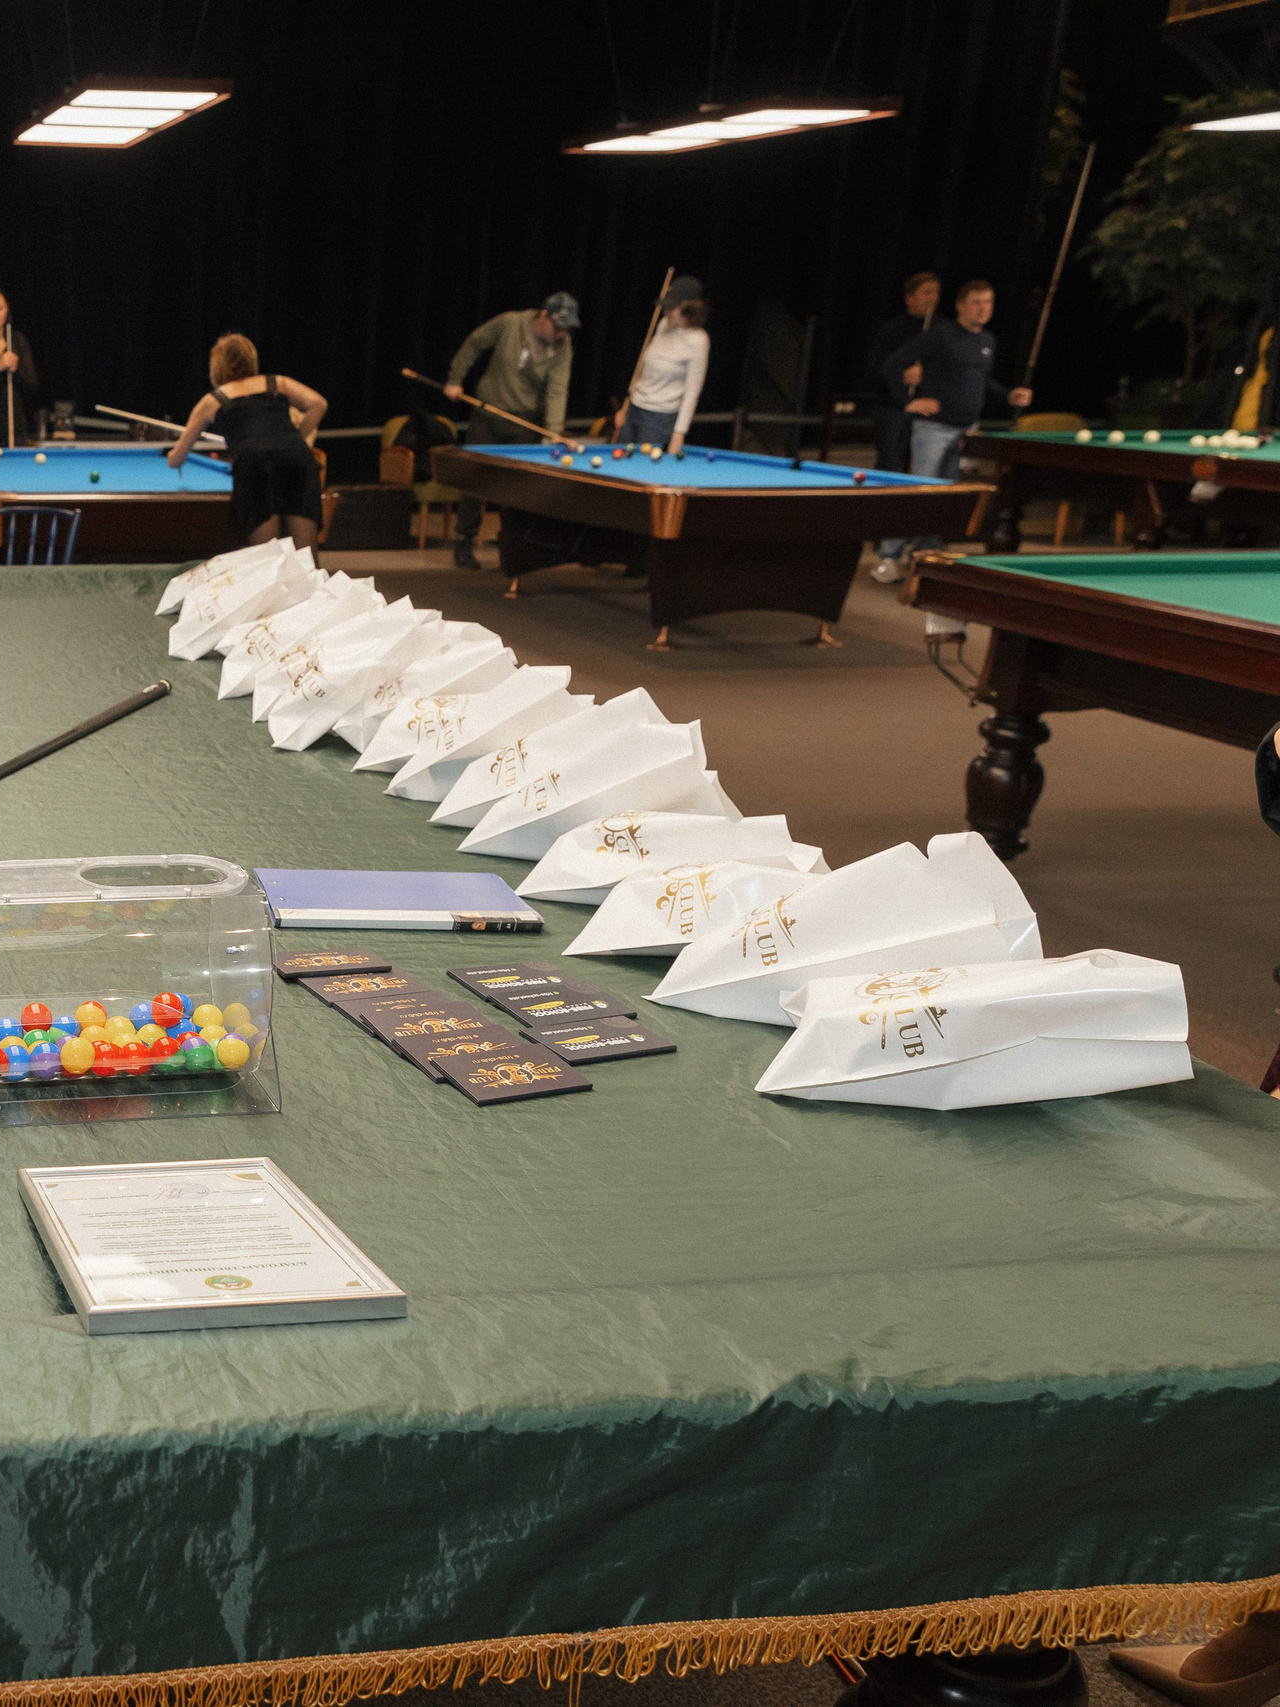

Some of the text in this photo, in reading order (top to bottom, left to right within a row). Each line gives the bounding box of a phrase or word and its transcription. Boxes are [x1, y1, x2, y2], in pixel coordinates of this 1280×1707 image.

[679, 881, 695, 936] CLUB
[751, 907, 780, 967] CLUB
[468, 1066, 562, 1084] FRBS CLUB
